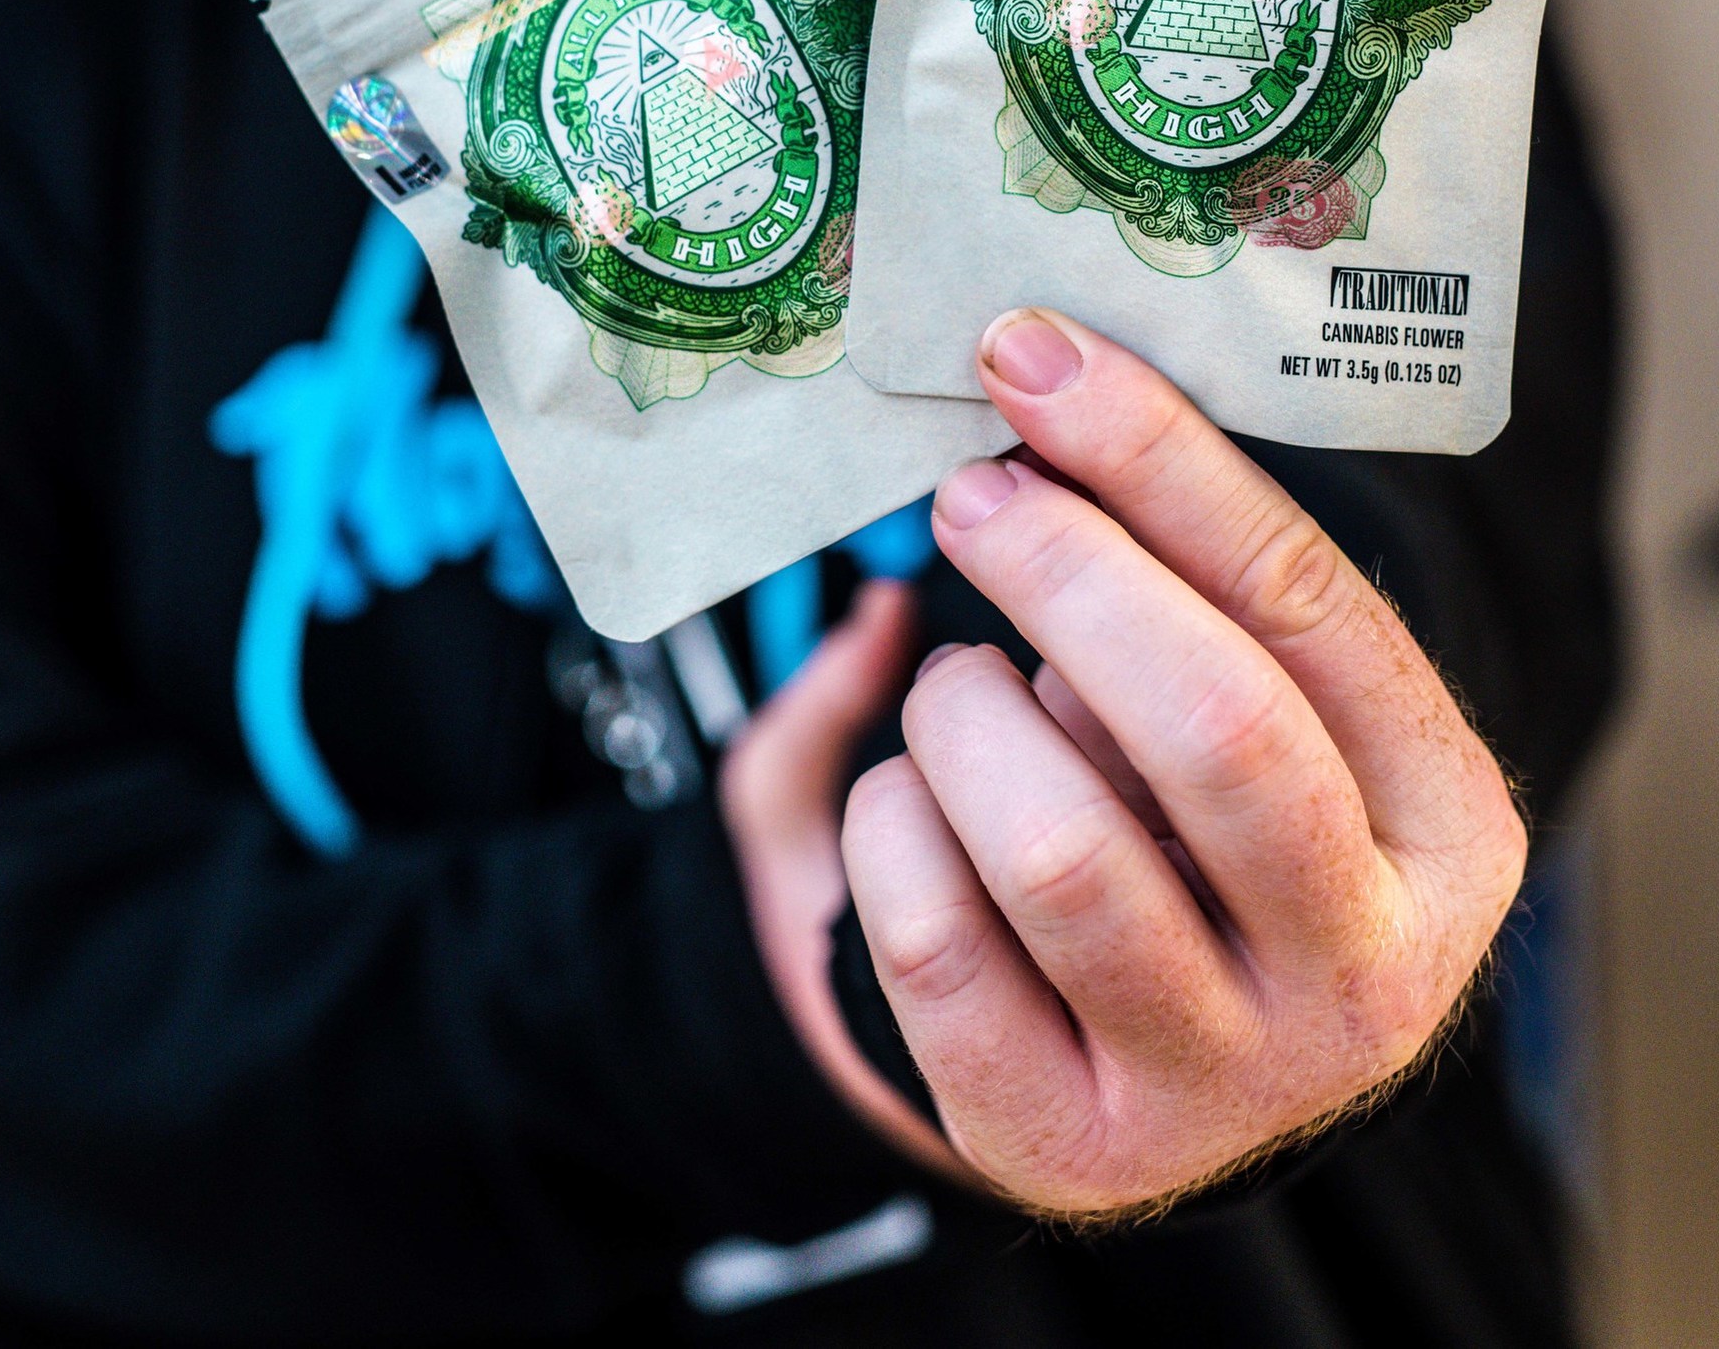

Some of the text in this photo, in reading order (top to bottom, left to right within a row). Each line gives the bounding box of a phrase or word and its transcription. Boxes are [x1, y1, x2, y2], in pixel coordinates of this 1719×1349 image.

[563, 10, 608, 71] ALL
[1111, 79, 1276, 142] HIGH
[671, 173, 811, 267] HIGH
[1337, 270, 1465, 316] TRADITIONAL
[1322, 322, 1464, 349] CANNABIS FLOWER
[1281, 355, 1461, 386] NET WT 3.5g (0.125 OZ)
